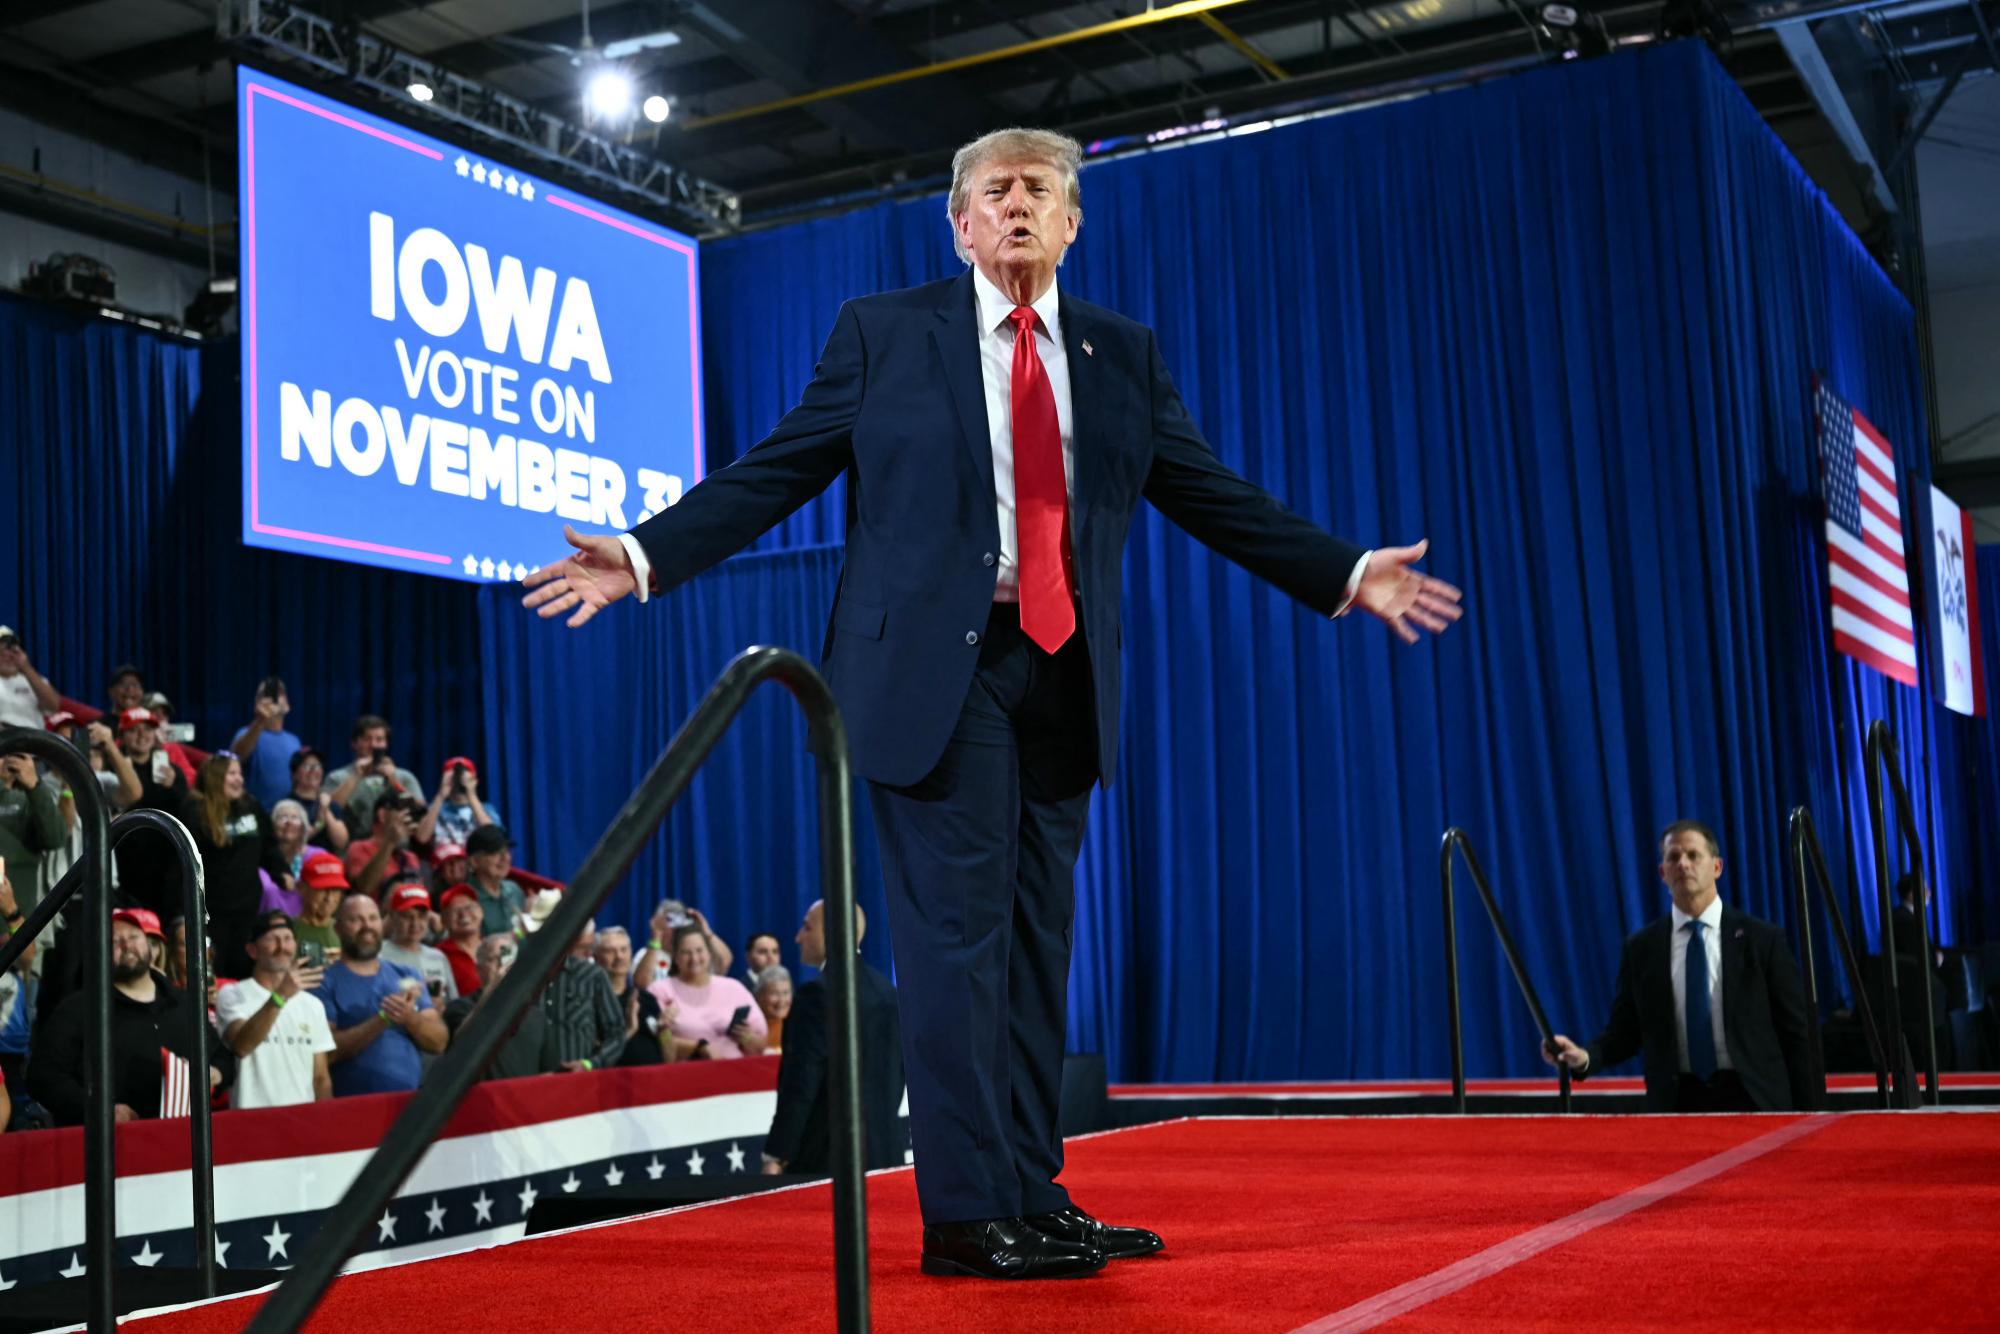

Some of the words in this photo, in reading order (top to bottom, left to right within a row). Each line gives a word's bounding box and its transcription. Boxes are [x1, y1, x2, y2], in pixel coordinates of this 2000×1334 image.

[370, 211, 612, 384] IOWA
[280, 381, 628, 530] NOVEMBER
[395, 338, 520, 424] VOTE
[531, 378, 595, 443] ON
